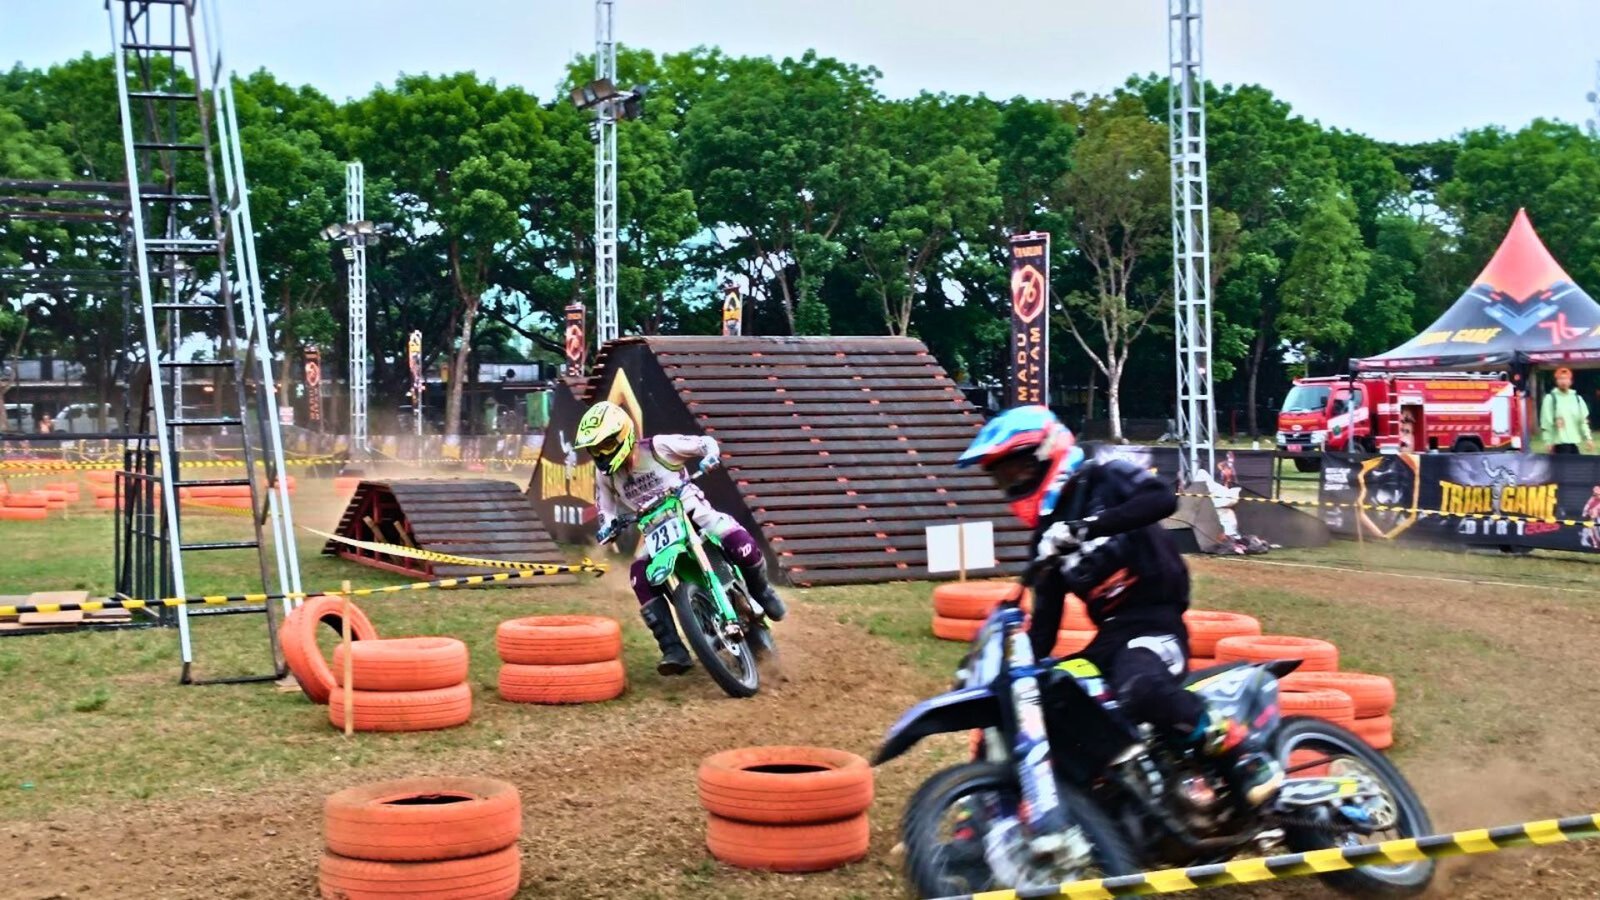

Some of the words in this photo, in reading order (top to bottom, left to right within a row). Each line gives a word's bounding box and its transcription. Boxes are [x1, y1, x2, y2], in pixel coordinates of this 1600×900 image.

[1017, 333, 1028, 402] MADU
[1029, 327, 1041, 402] HITAM
[1439, 480, 1493, 514] TRIAL
[1500, 483, 1559, 522] GAME
[651, 525, 670, 553] 23
[1465, 519, 1526, 536] DIRT
